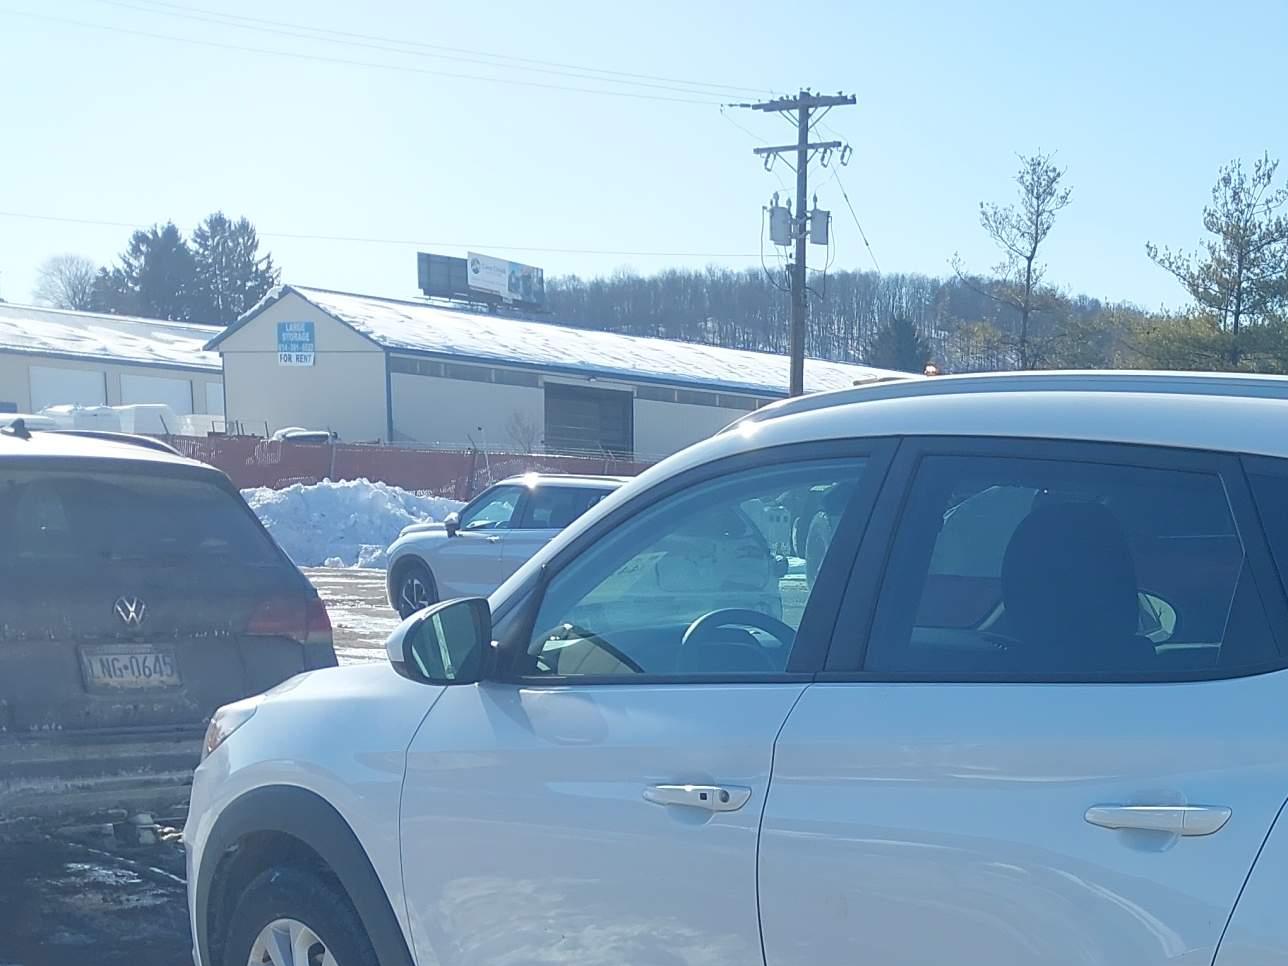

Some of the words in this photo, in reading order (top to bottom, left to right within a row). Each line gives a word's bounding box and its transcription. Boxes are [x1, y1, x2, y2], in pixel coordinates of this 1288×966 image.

[281, 332, 310, 342] STORAGE
[279, 353, 292, 362] FOR
[295, 354, 312, 363] RENT
